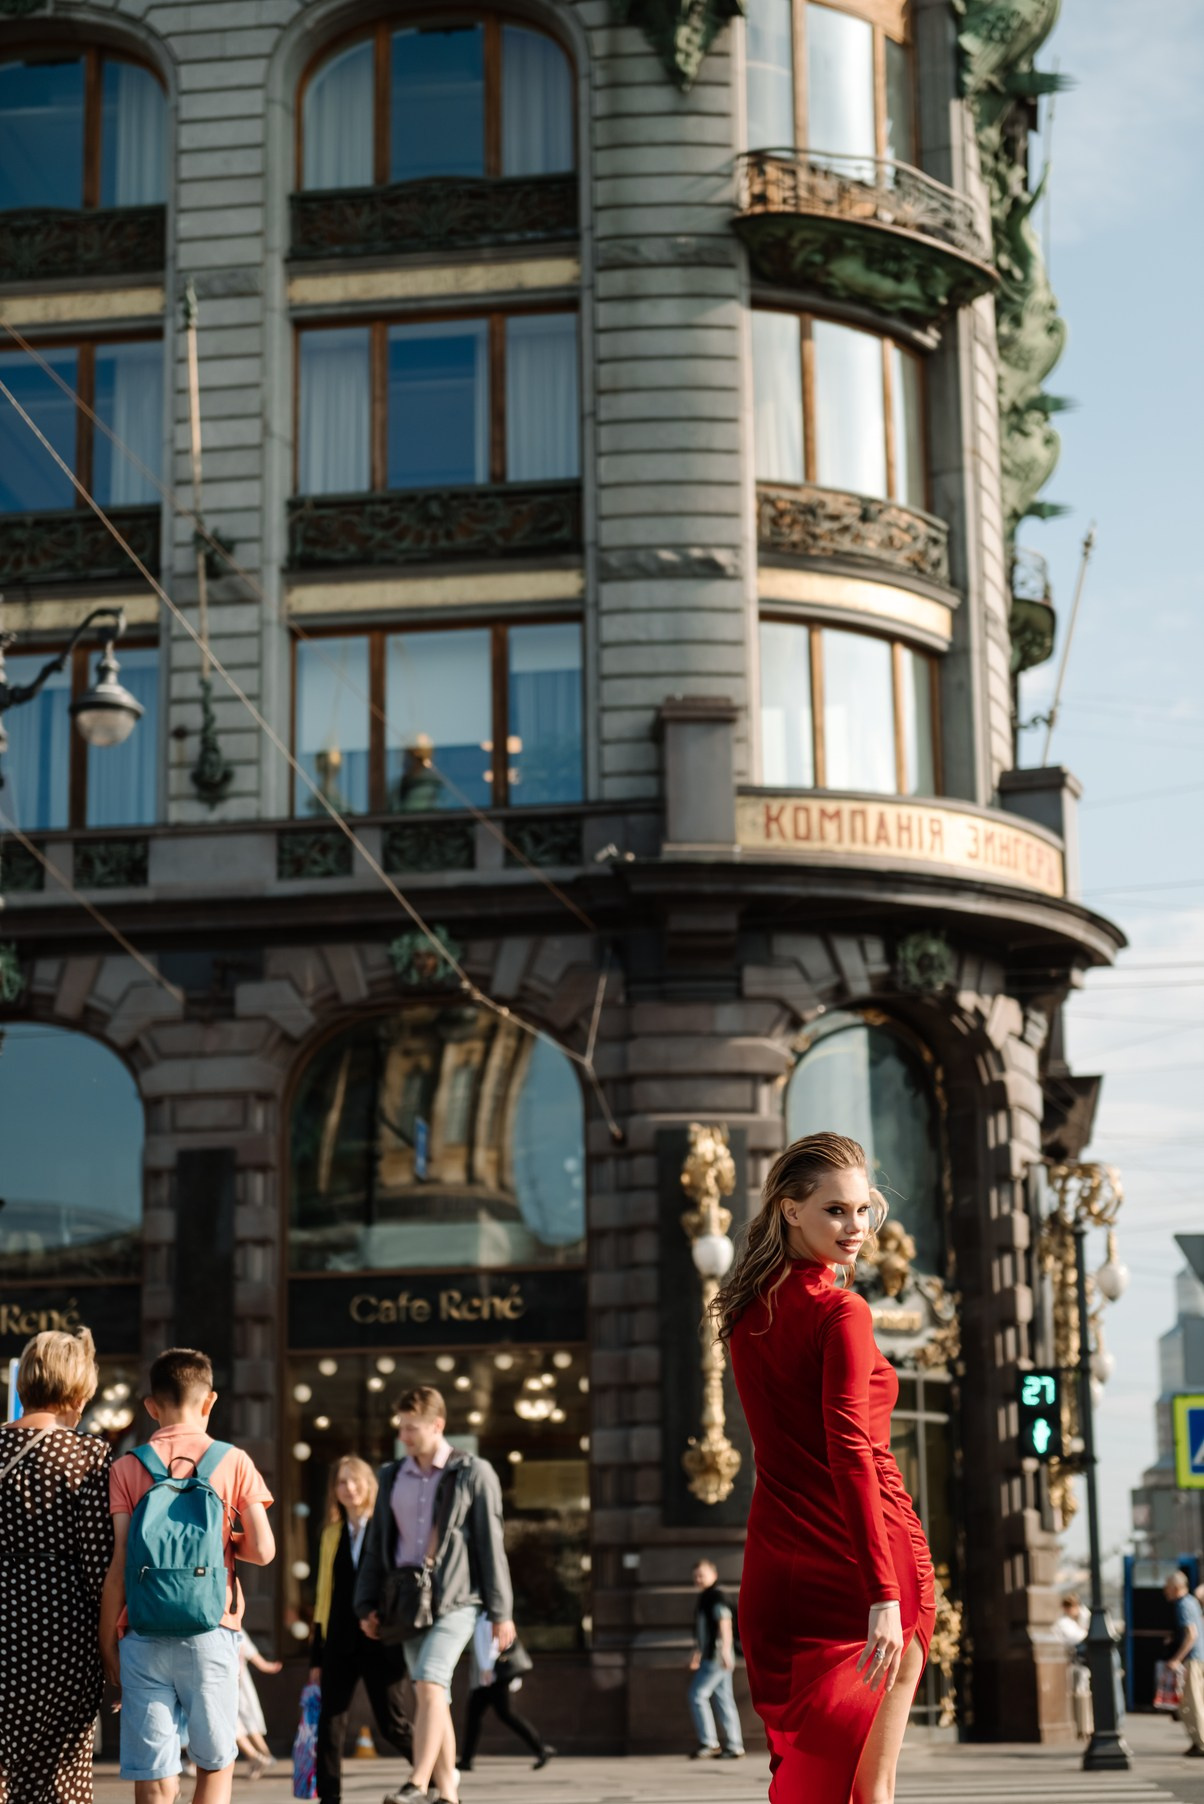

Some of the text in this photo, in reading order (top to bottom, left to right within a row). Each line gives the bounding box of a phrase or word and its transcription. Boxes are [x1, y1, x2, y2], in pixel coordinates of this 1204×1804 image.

[764, 803, 943, 854] КОМПАНІЯ
[349, 1284, 525, 1324] Cafe René
[1022, 1375, 1056, 1406] 27
